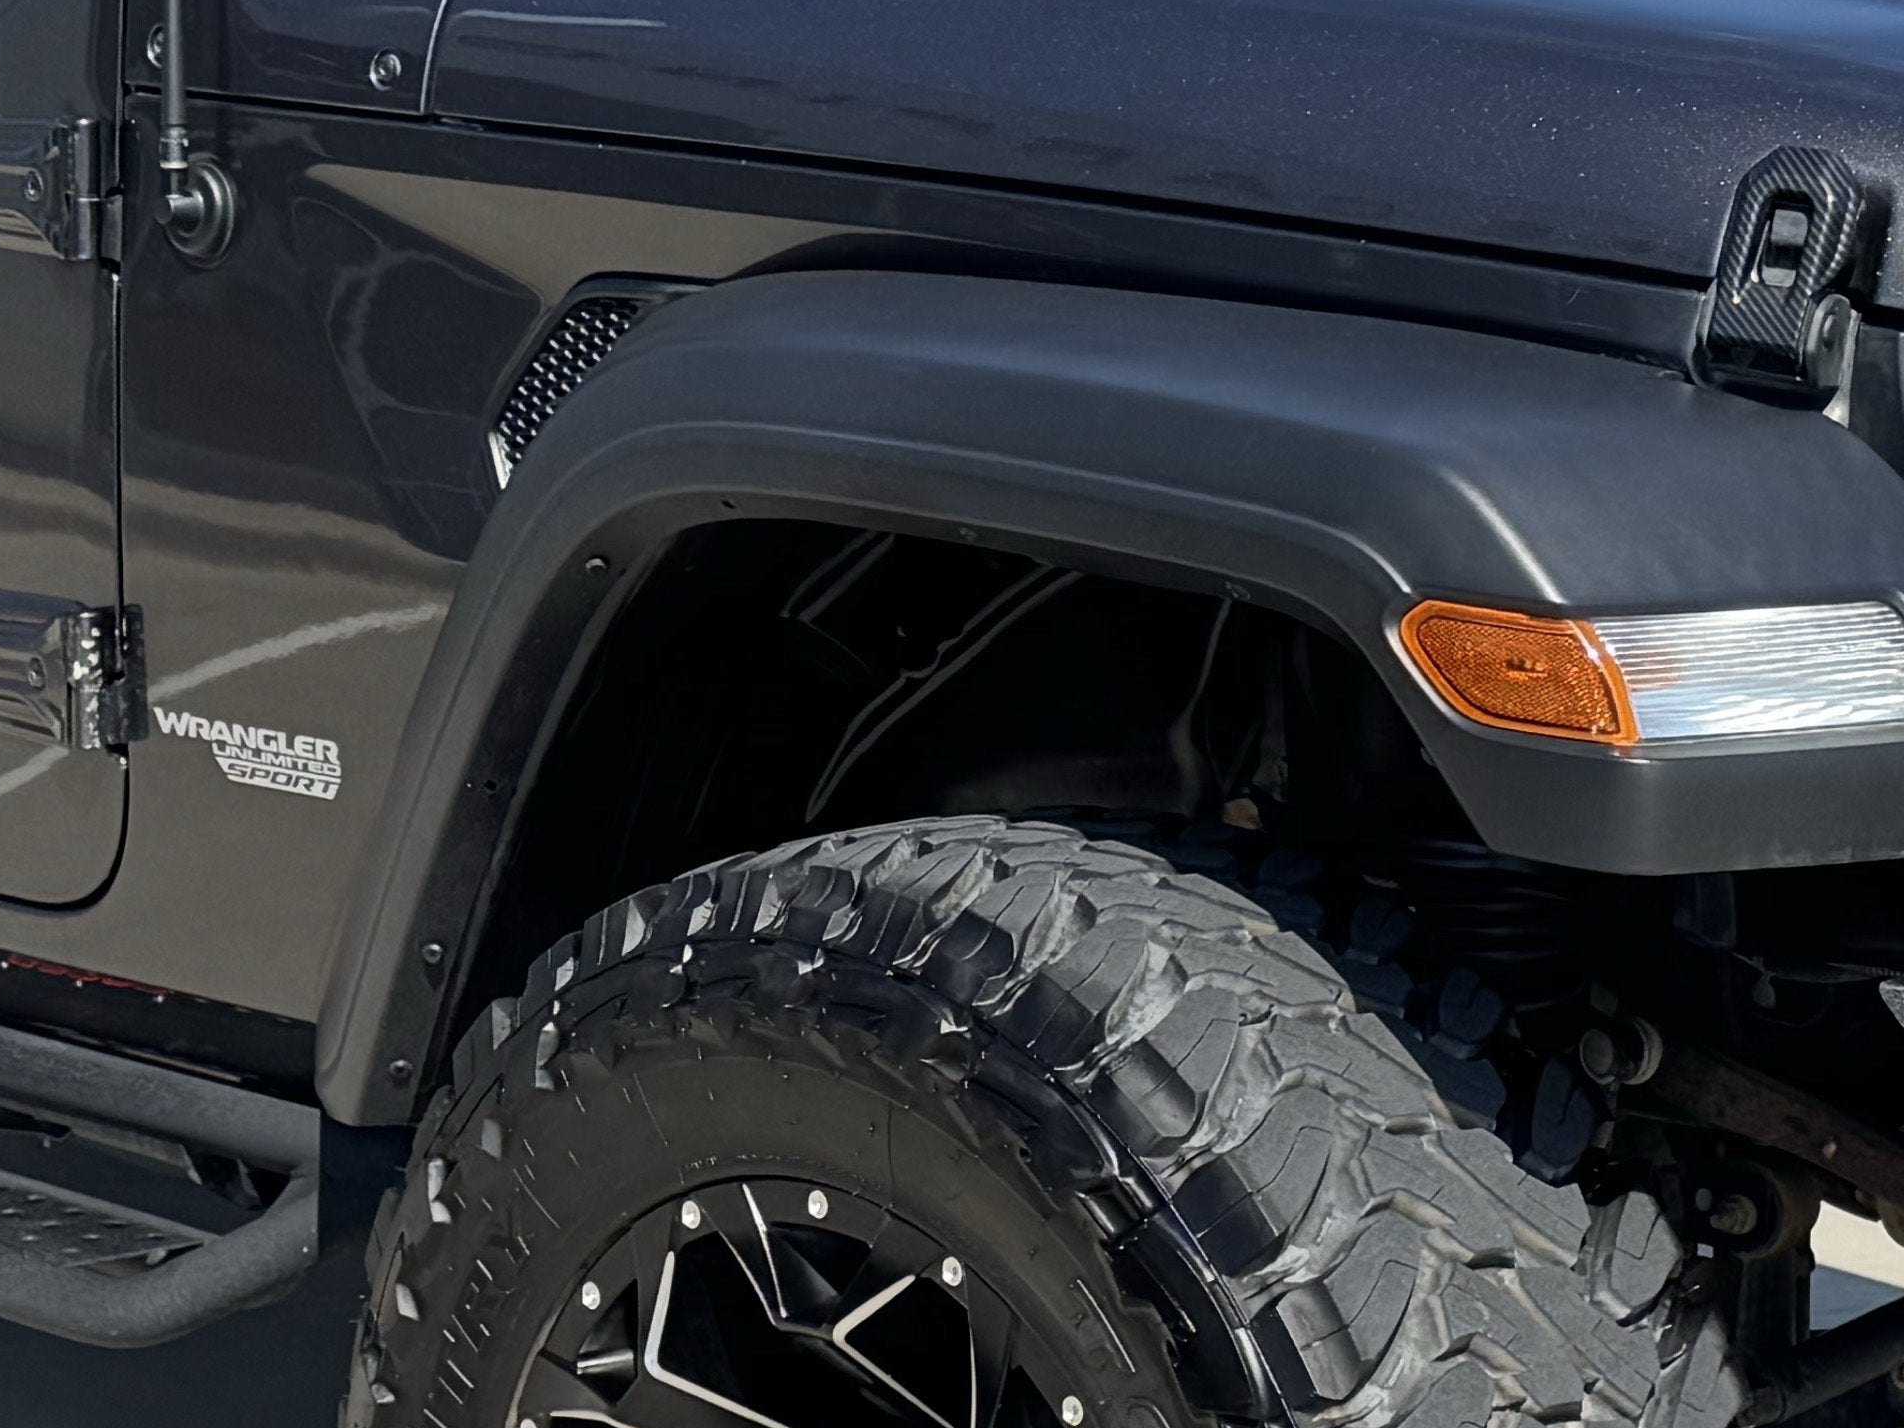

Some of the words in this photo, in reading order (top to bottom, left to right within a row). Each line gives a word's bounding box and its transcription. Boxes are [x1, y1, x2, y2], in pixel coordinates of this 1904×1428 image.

[152, 706, 341, 765] WRANGLER
[212, 743, 342, 777] UNLIMITED
[227, 761, 340, 796] SPORT
